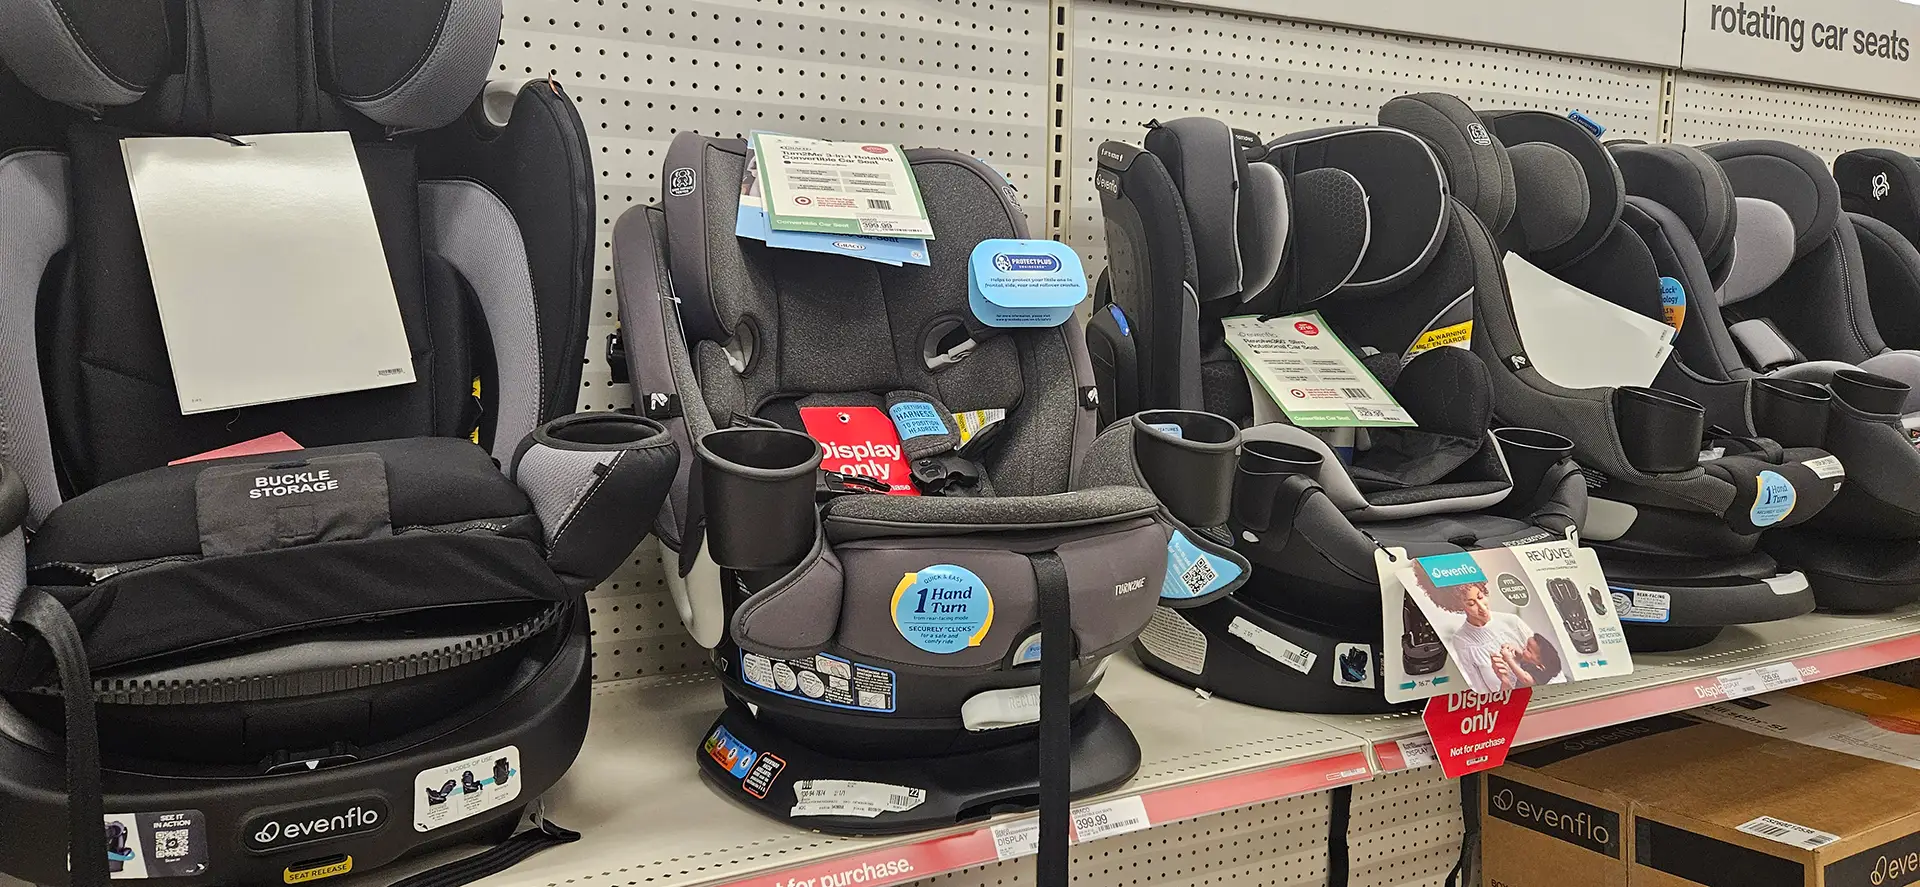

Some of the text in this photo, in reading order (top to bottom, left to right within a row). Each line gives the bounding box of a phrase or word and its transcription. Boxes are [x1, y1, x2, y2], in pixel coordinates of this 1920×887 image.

[1710, 2, 1910, 62] rotating car seats
[782, 154, 837, 163] Convertible
[853, 154, 894, 164] Rotating
[776, 219, 817, 227] Convertible
[1435, 328, 1467, 341] WARNING
[1442, 335, 1467, 345] GARDE
[896, 410, 935, 421] HARNESS
[908, 426, 940, 434] HEADREST
[911, 420, 940, 428] POSITION
[819, 440, 901, 461] Display
[840, 459, 890, 481] only
[255, 469, 331, 488] BUCKLE
[249, 479, 339, 499] STORAGE
[1765, 483, 1789, 505] 1 Hand
[1441, 563, 1477, 577] evenflo
[923, 575, 942, 585] QUICK
[948, 574, 964, 584] EASY
[1500, 585, 1526, 593] CHILDREN
[914, 586, 973, 614] 1 Hand
[931, 602, 967, 614] Turn
[908, 625, 943, 633] SECURELY
[1694, 683, 1724, 699] Displa
[1008, 692, 1041, 709] RECLIN
[1460, 707, 1500, 735] only
[1405, 746, 1429, 758] DISPLAY
[1450, 737, 1506, 757] Not for purchase
[449, 762, 471, 773] MODES
[480, 755, 493, 763] USE
[908, 787, 920, 797] 22
[160, 814, 176, 822] SEE
[162, 819, 192, 828] ACTION
[283, 806, 379, 838] evenflo
[1075, 813, 1108, 831] 399.99
[1516, 798, 1611, 845] evenflo
[997, 832, 1029, 847] DISPLAY
[289, 863, 348, 881] SEAT RELEASE
[819, 858, 915, 887] purchase.
[1888, 851, 1920, 879] eve
